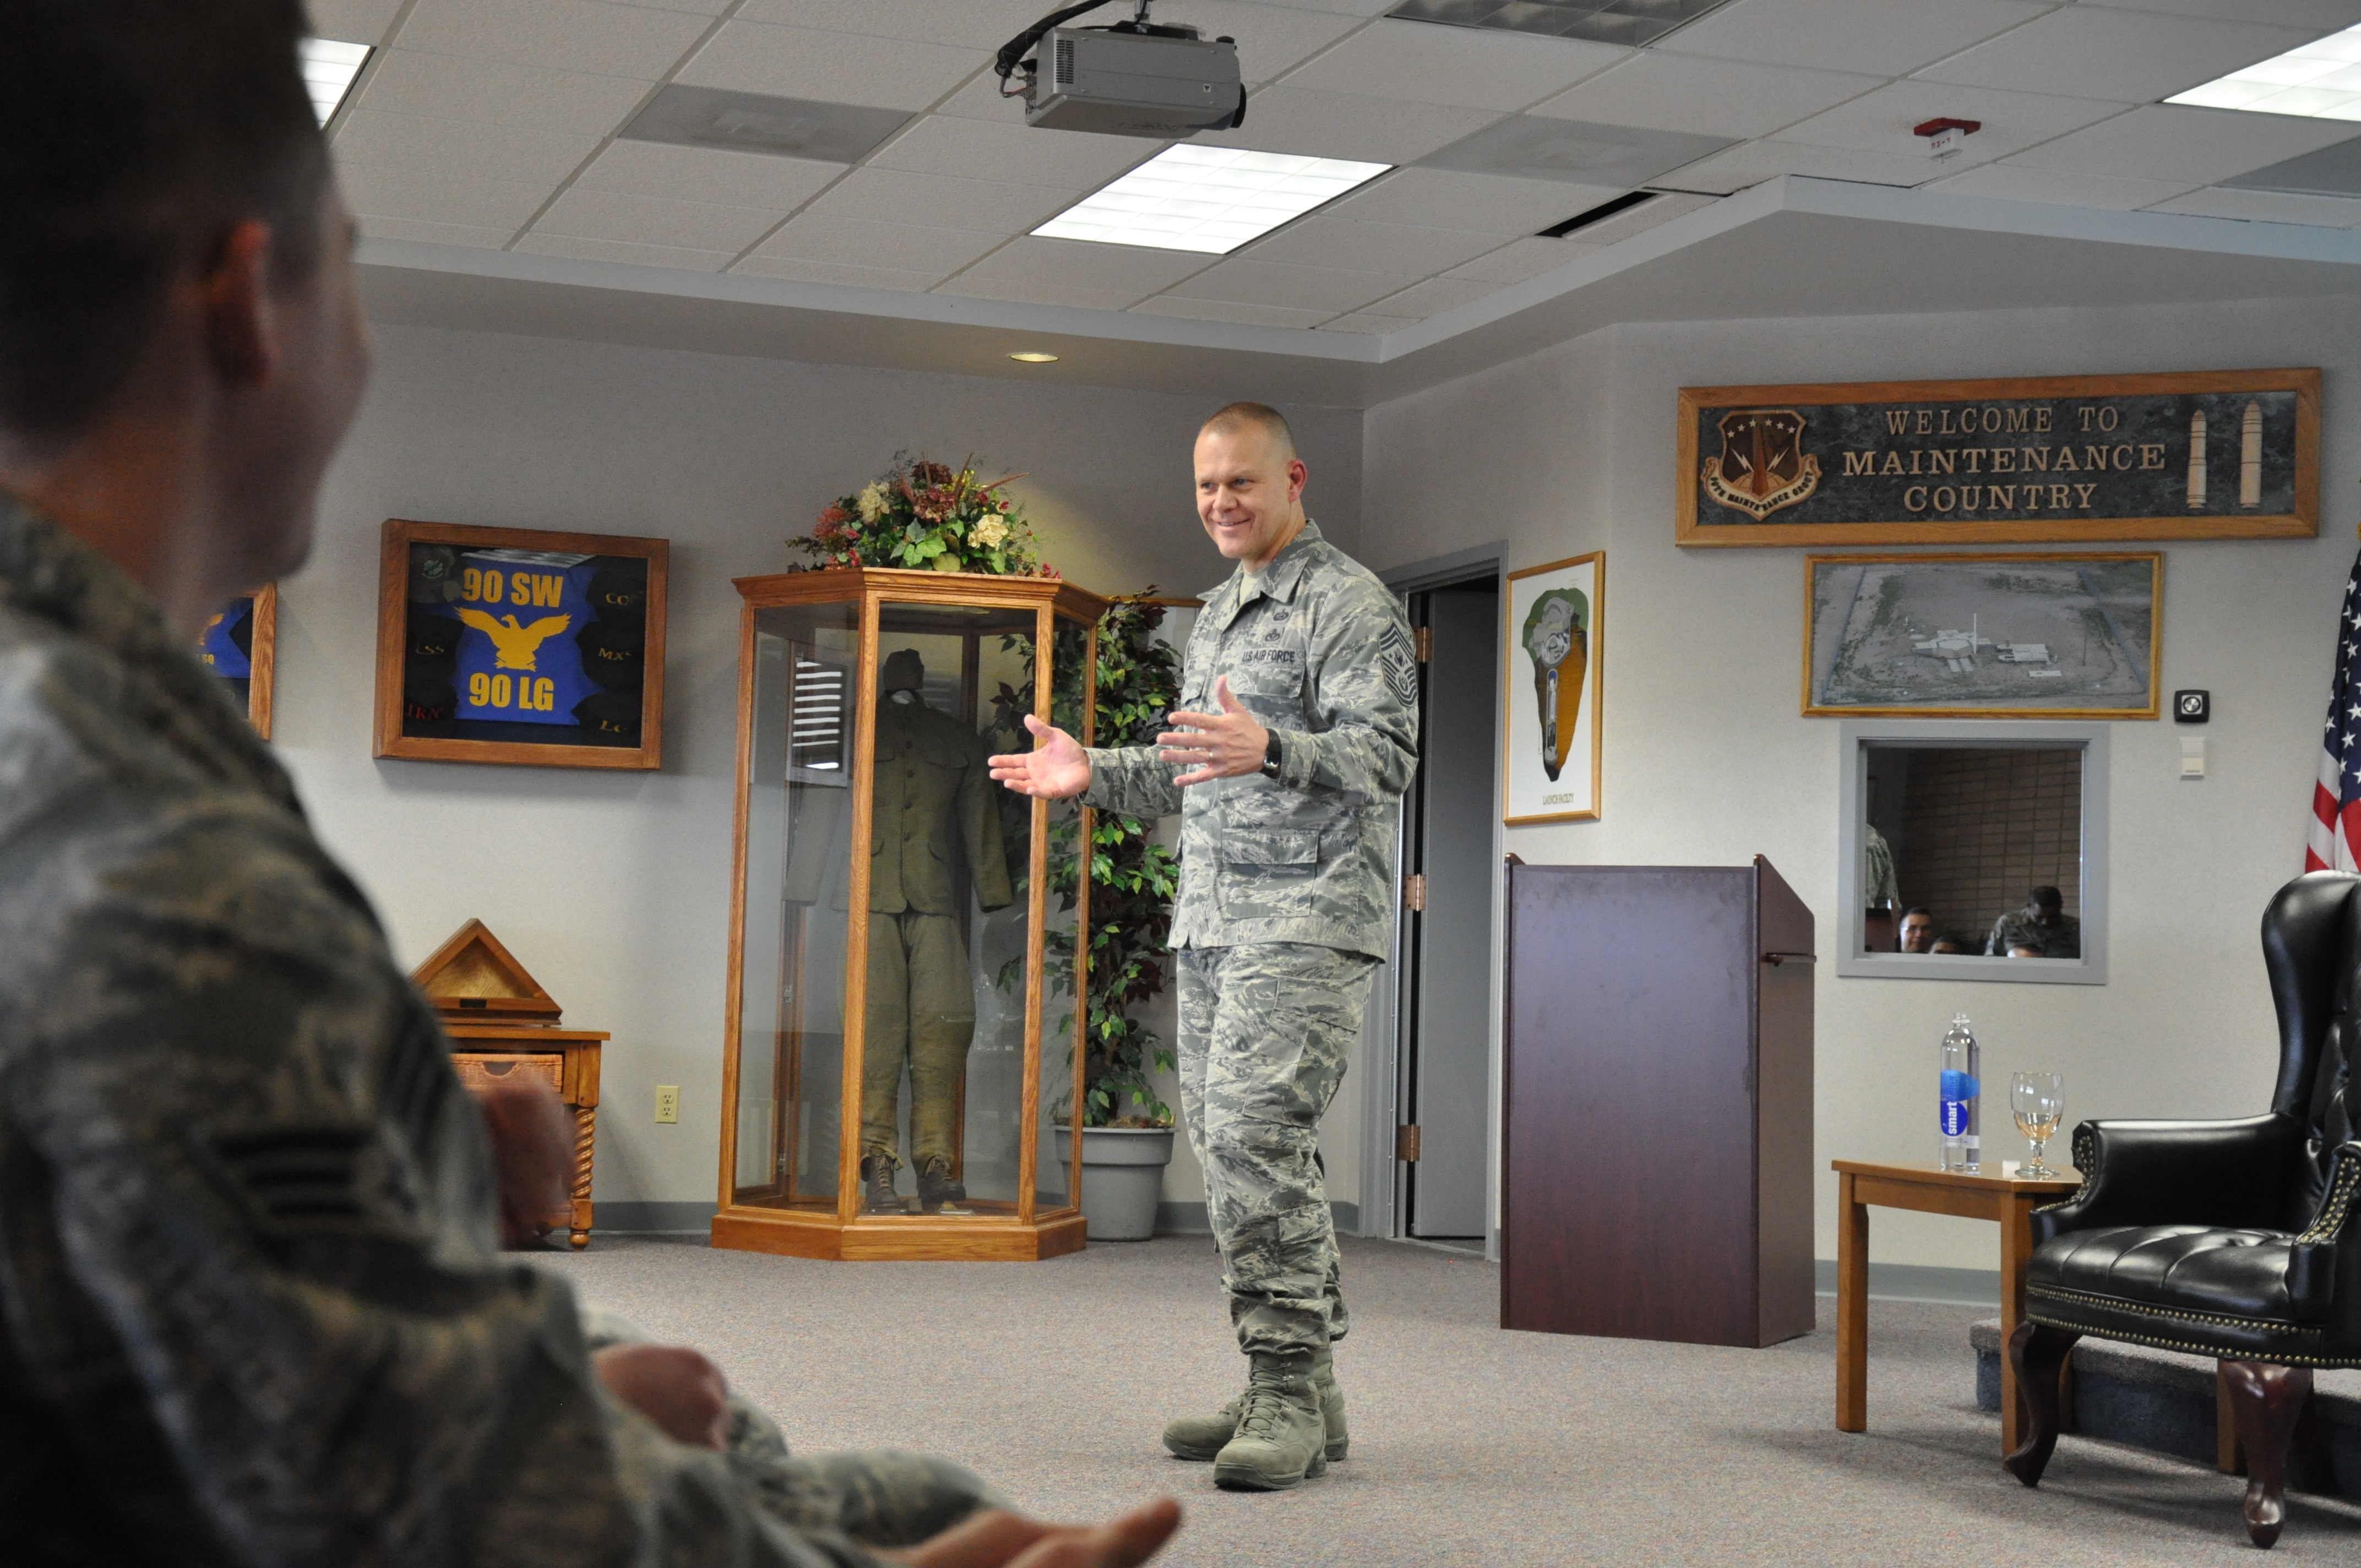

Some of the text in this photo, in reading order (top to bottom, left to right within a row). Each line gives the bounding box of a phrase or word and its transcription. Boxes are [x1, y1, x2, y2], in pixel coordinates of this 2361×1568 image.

[1886, 406, 2119, 435] WELCOME TO
[1842, 444, 2166, 477] MAINTENANCE
[1727, 492, 1790, 511] MAINTENANCE
[1903, 483, 2097, 511] COUNTRY
[463, 569, 563, 608] 90 SW
[1253, 650, 1266, 661] AIR
[1266, 650, 1296, 663] FORCE
[469, 673, 554, 711] 90 LG
[1947, 1101, 1957, 1135] smart
